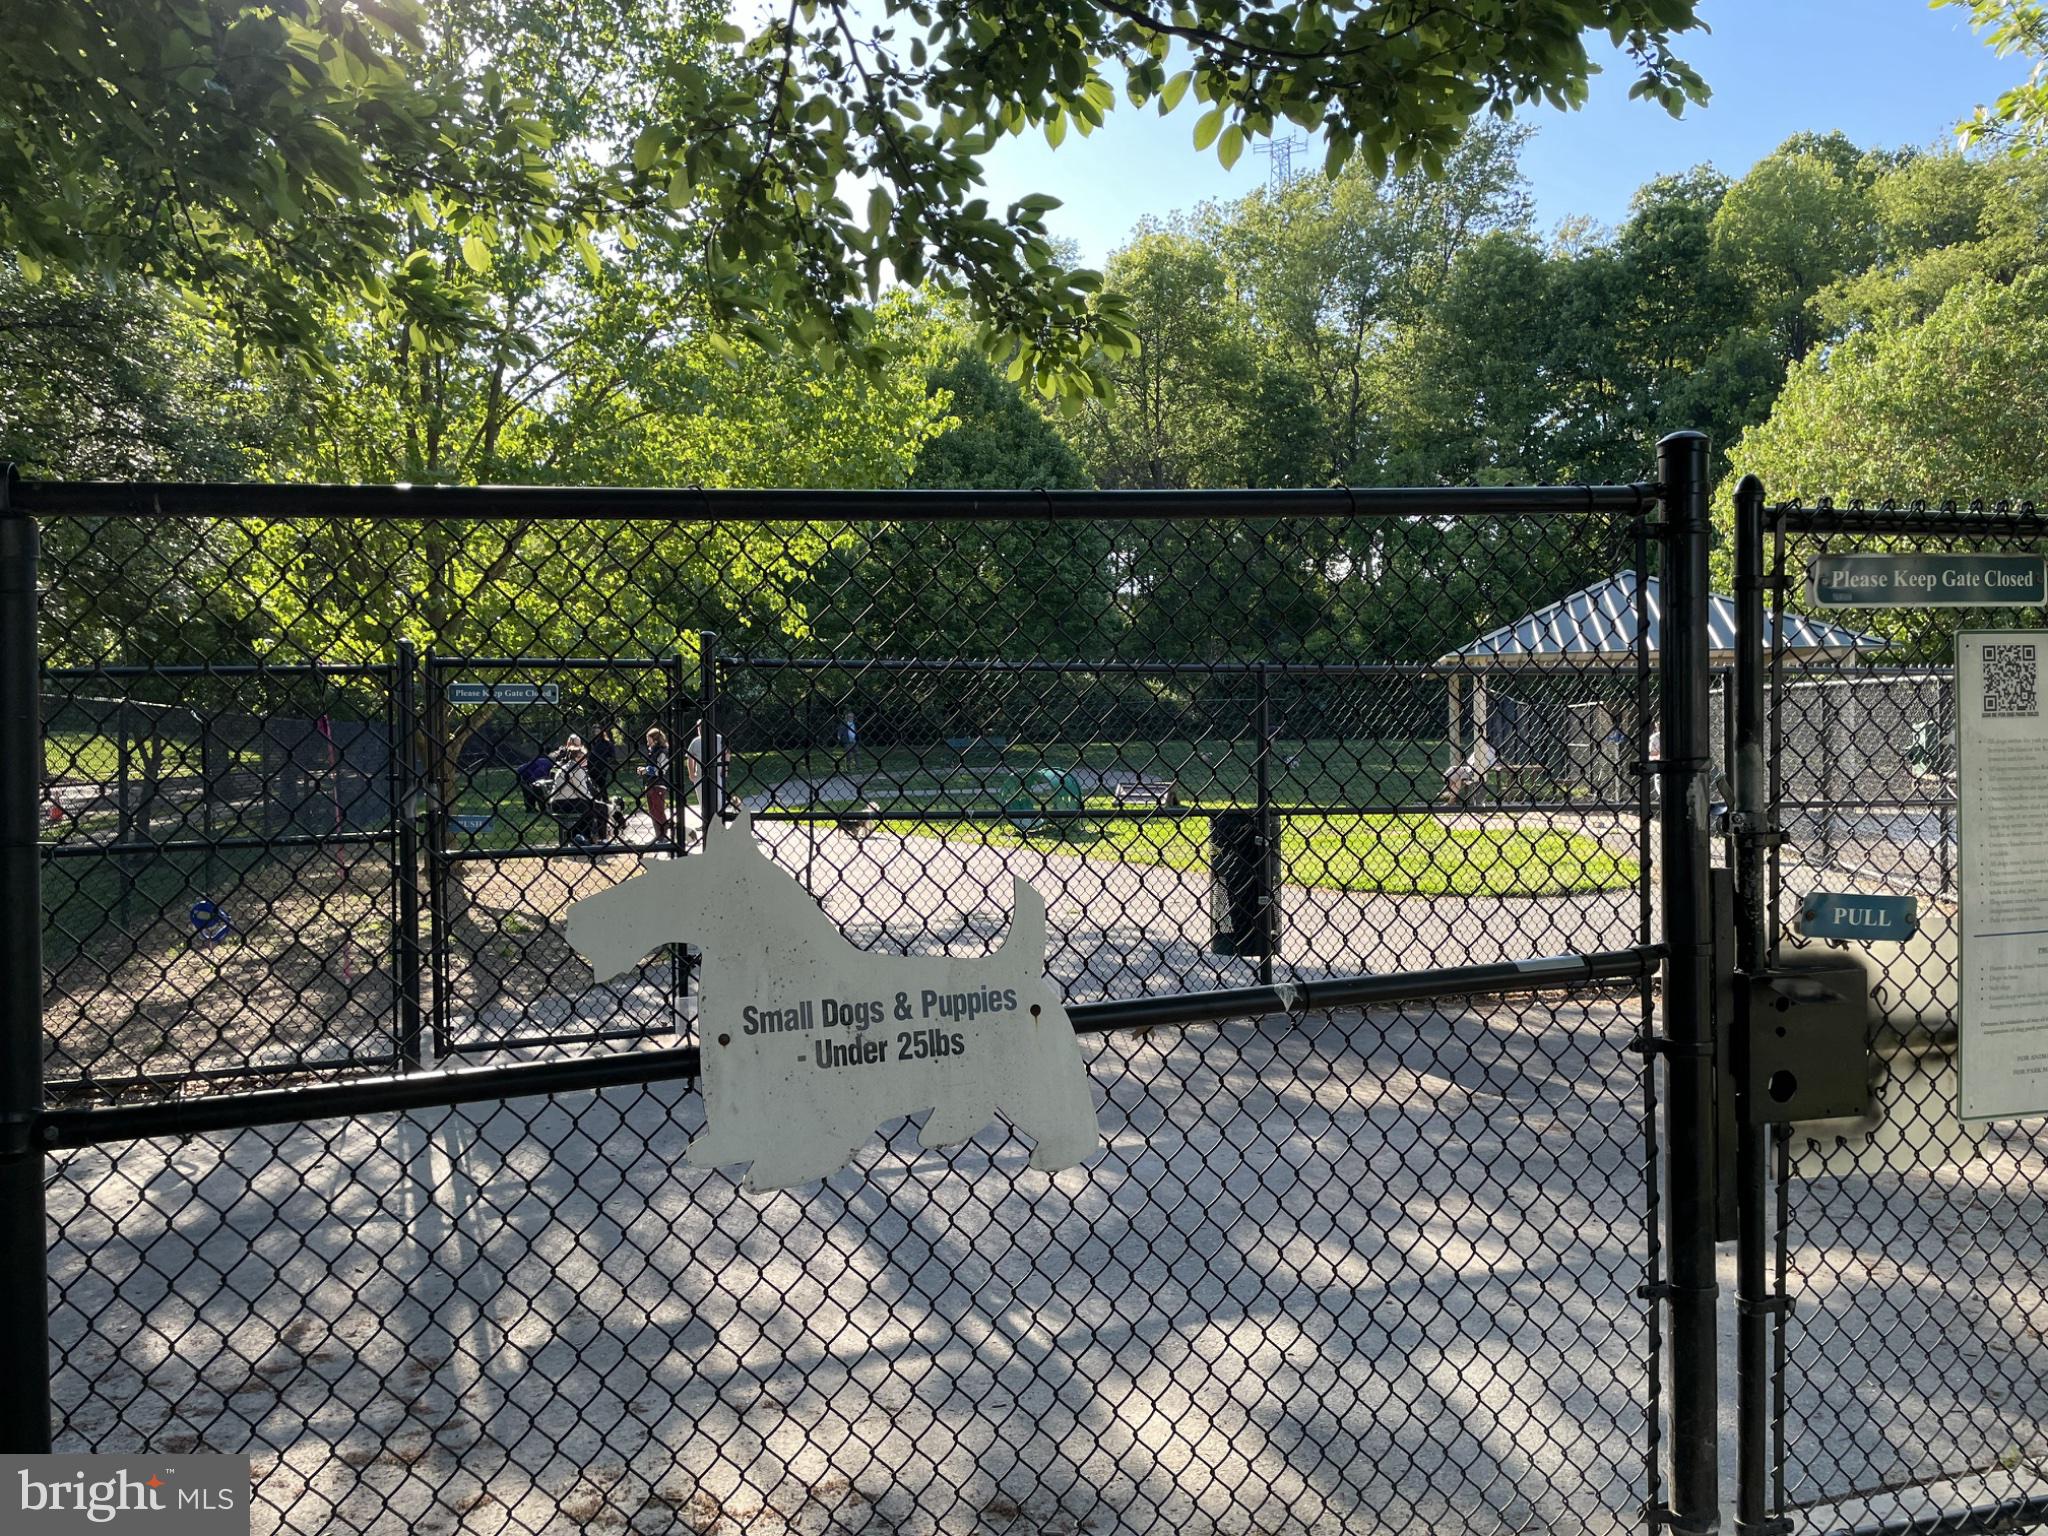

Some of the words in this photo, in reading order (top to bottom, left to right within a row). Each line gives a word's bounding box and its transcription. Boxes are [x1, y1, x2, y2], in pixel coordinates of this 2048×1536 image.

[1831, 570, 1889, 588] Please
[1893, 569, 1937, 591] Keep
[1942, 569, 1981, 587] Gate
[1984, 569, 2033, 587] Closed
[455, 689, 480, 697] Please
[482, 689, 503, 698] Kep
[504, 689, 523, 697] Gate
[525, 689, 552, 697] Cloed
[1833, 907, 1892, 927] PULL
[743, 1001, 814, 1035] Small
[821, 998, 885, 1031] Dogs
[893, 991, 914, 1020] &
[921, 985, 1018, 1022] Puppies
[815, 1039, 888, 1069] Under
[897, 1028, 965, 1061] 25lbs
